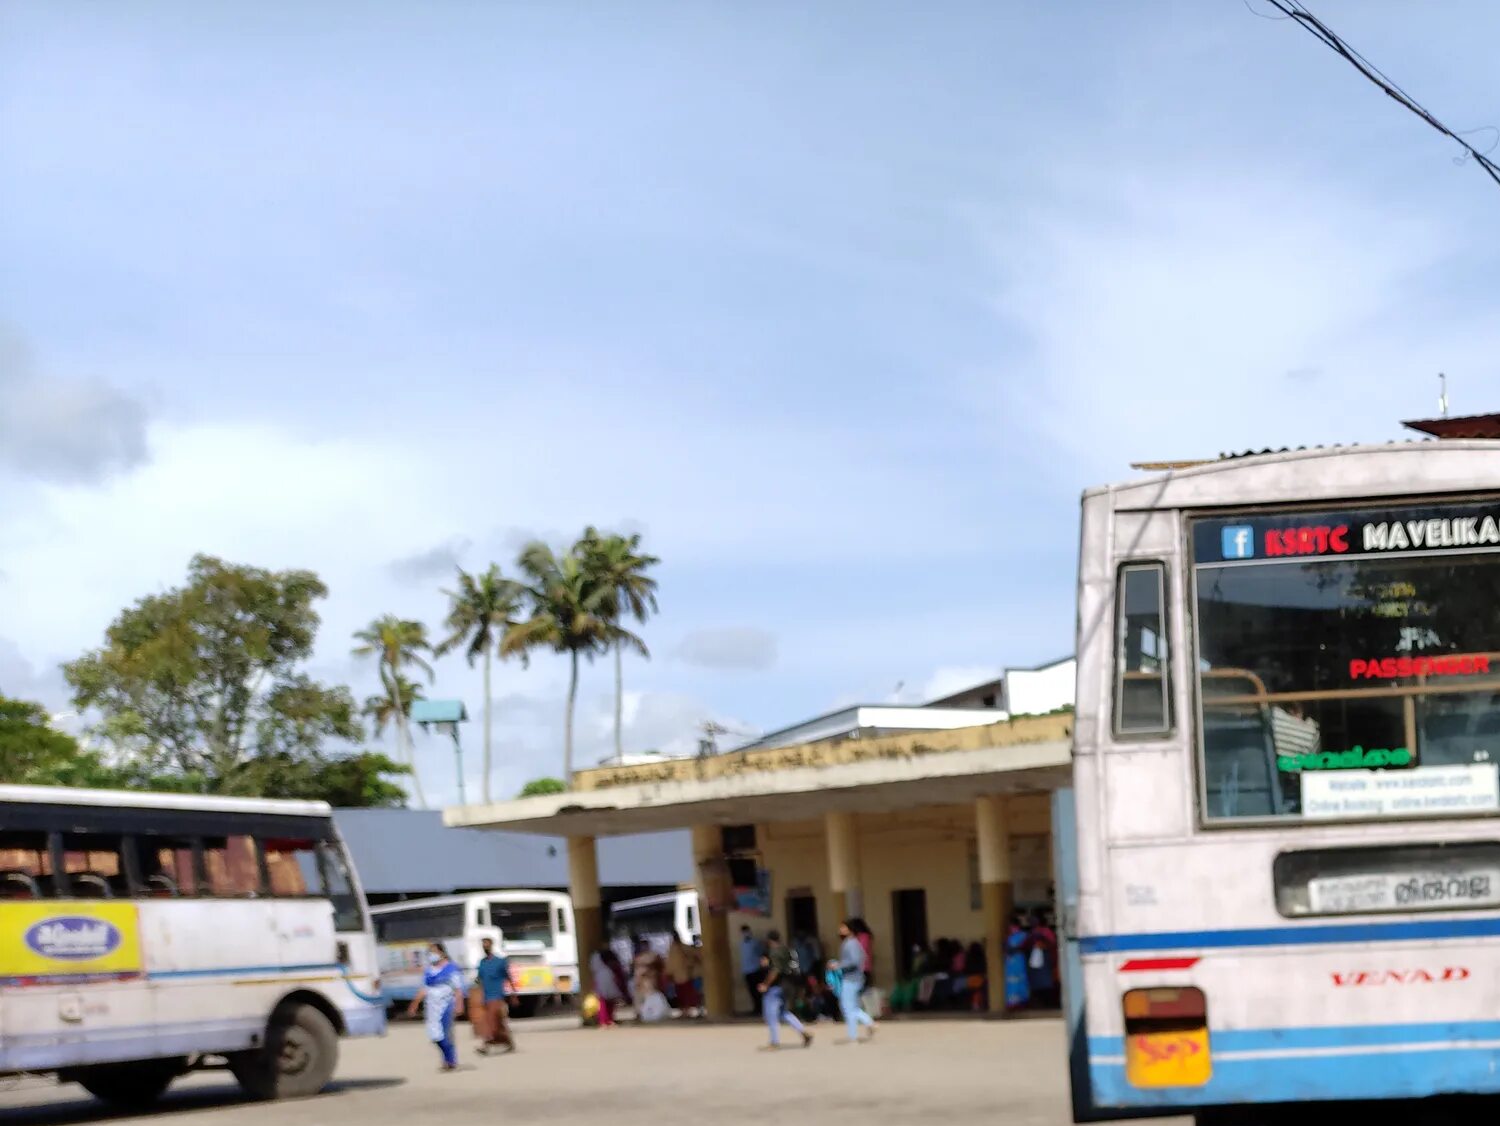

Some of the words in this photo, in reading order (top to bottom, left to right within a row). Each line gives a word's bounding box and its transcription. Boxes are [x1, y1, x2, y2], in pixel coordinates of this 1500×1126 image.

[1264, 525, 1349, 556] KSRTC
[1350, 656, 1490, 679] PASSENGER
[1331, 967, 1469, 987] VENAD
